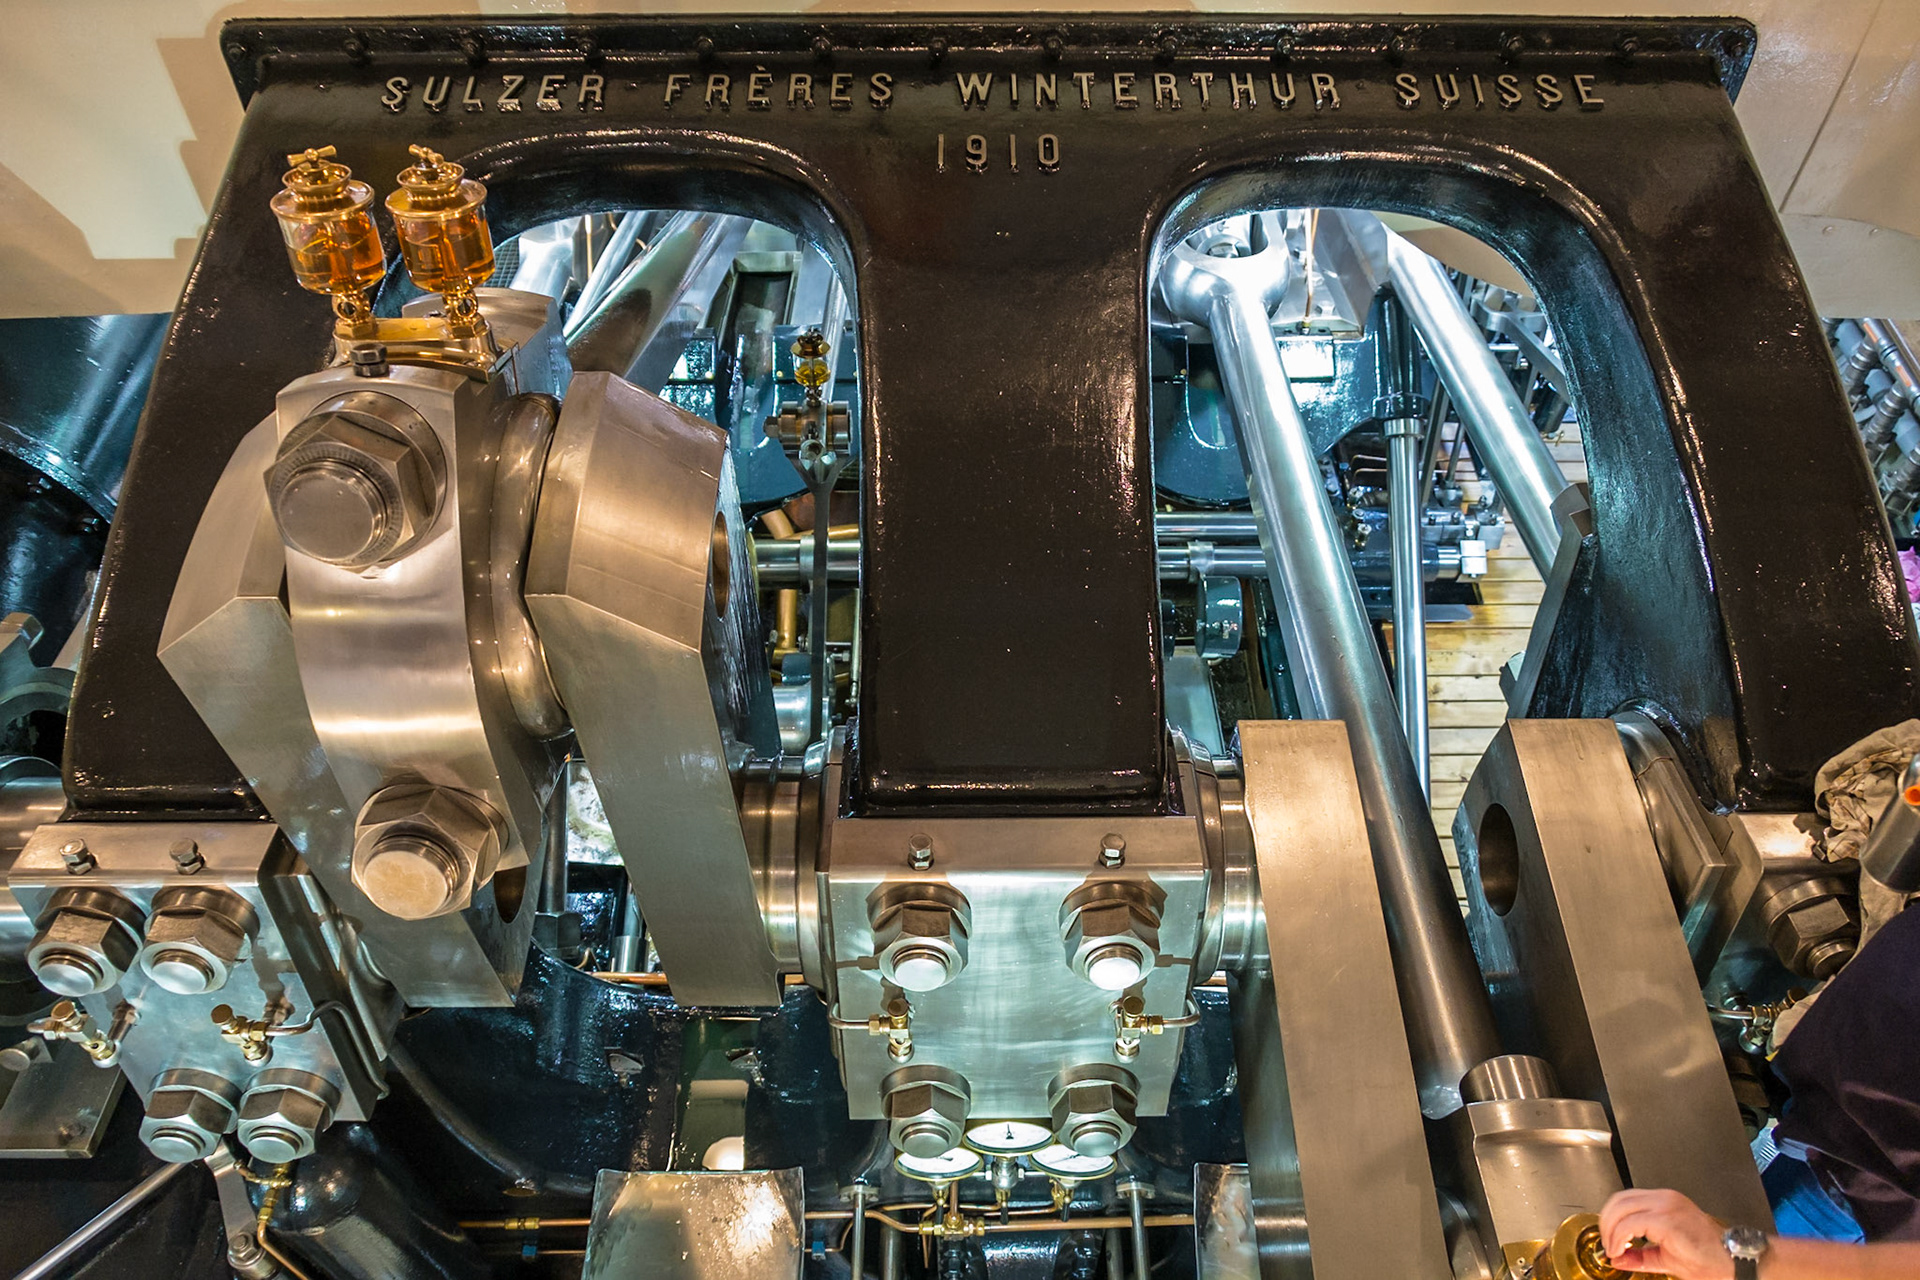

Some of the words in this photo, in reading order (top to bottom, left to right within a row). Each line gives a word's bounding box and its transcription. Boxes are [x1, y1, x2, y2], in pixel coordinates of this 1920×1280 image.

[381, 74, 604, 108] SULZER
[664, 65, 892, 107] FRÈRES
[956, 72, 1340, 107] WINTERTHUR
[1394, 73, 1604, 107] SUISSE
[937, 133, 1059, 170] 1910
